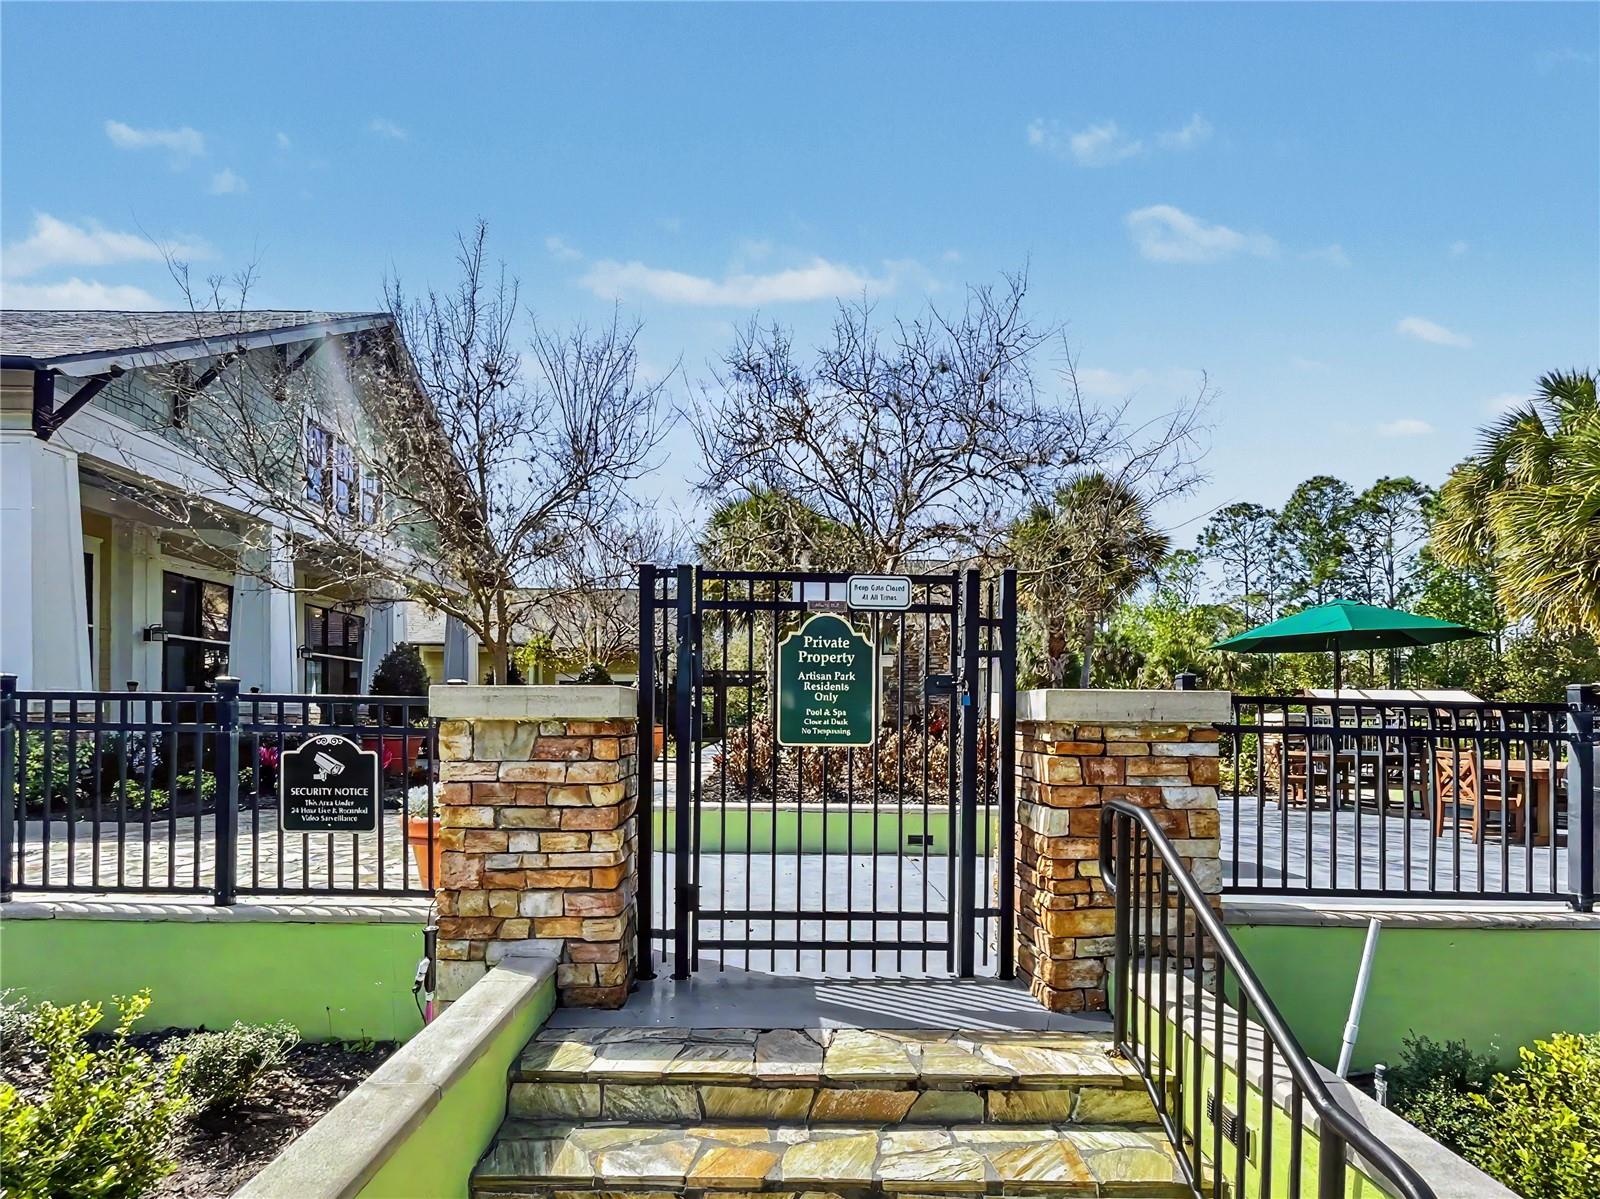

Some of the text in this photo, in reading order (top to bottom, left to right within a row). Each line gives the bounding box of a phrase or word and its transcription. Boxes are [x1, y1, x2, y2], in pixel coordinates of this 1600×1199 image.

[885, 584, 905, 592] Closed
[803, 635, 850, 649] Private
[798, 650, 855, 667] Property
[798, 671, 856, 681] Artisan Park
[803, 681, 849, 691] Residents
[814, 692, 839, 704] Only
[806, 708, 823, 716] Pool
[832, 708, 847, 718] Spa
[822, 718, 829, 726] at
[830, 718, 848, 726] Dusk
[801, 727, 851, 736] No Trespassing
[290, 787, 369, 796] SECURITY NOTICE
[301, 814, 358, 822] Video Surveillance
